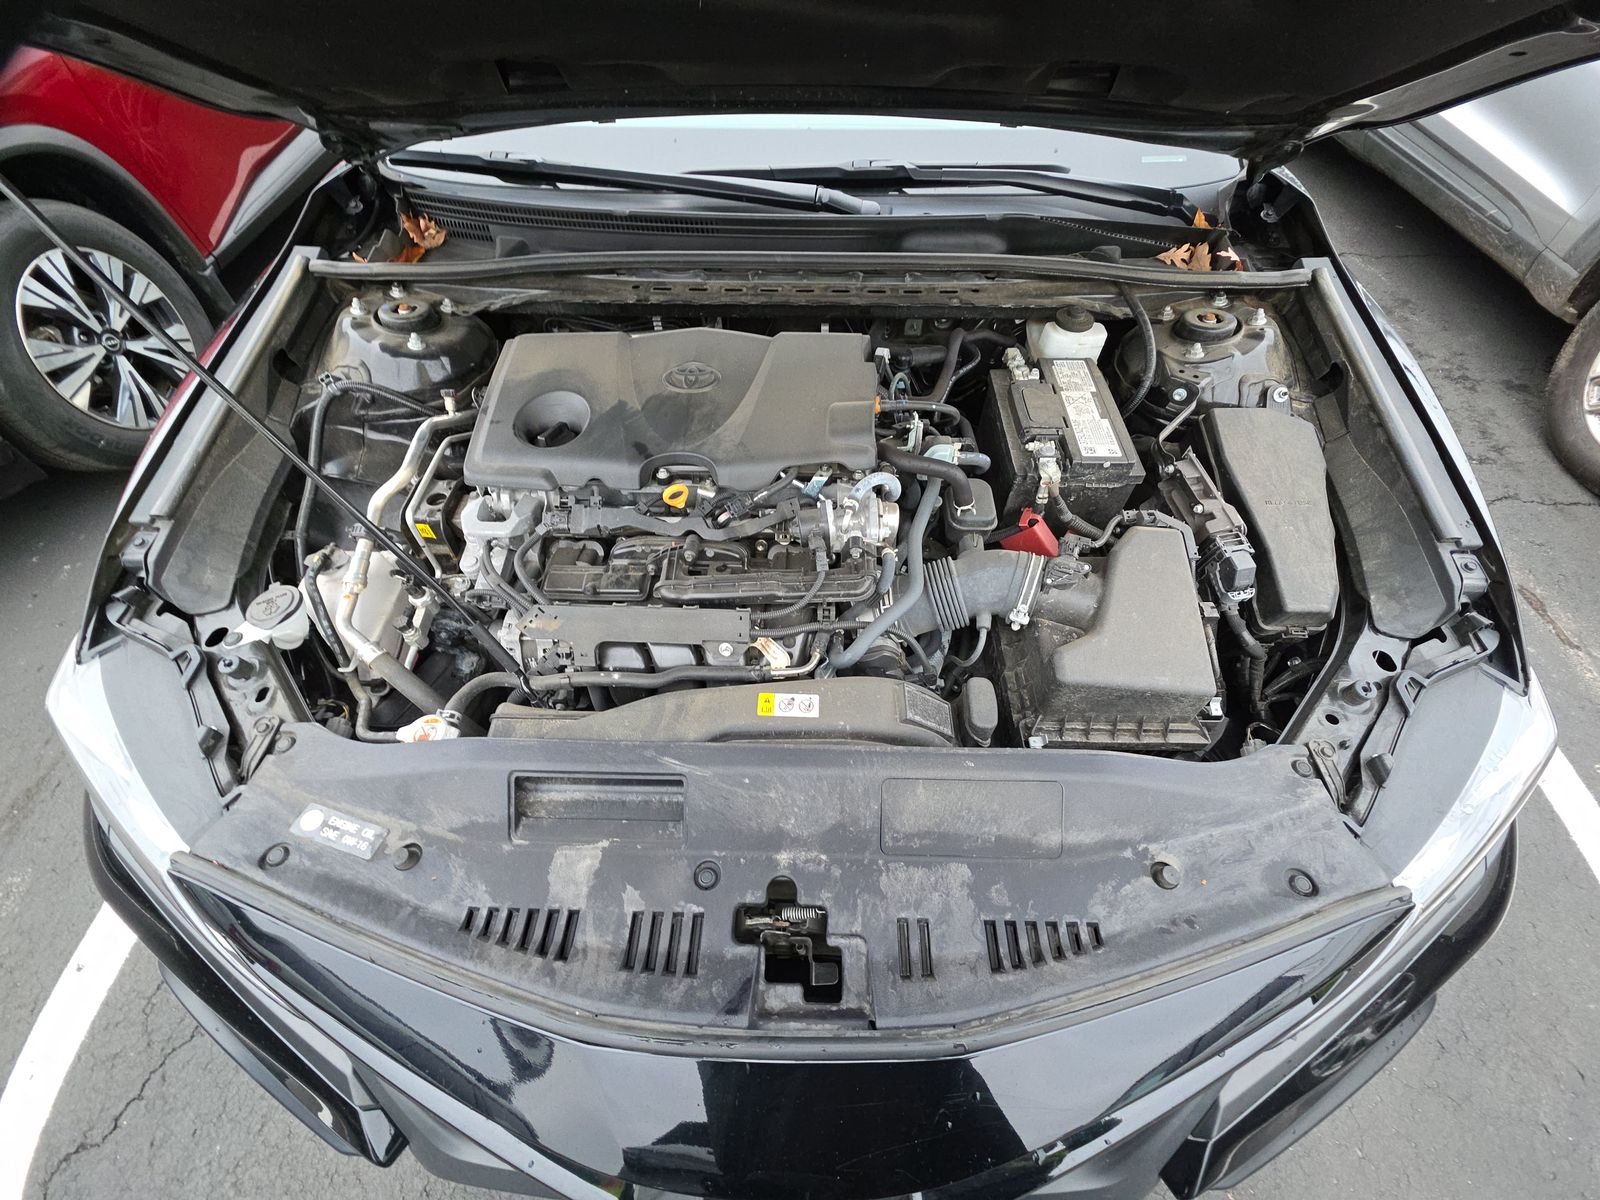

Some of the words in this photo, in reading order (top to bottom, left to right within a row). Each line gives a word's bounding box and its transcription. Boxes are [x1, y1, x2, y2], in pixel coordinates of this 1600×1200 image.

[319, 826, 341, 841] SAE
[328, 815, 361, 834] ENGINE
[361, 827, 376, 841] OIL
